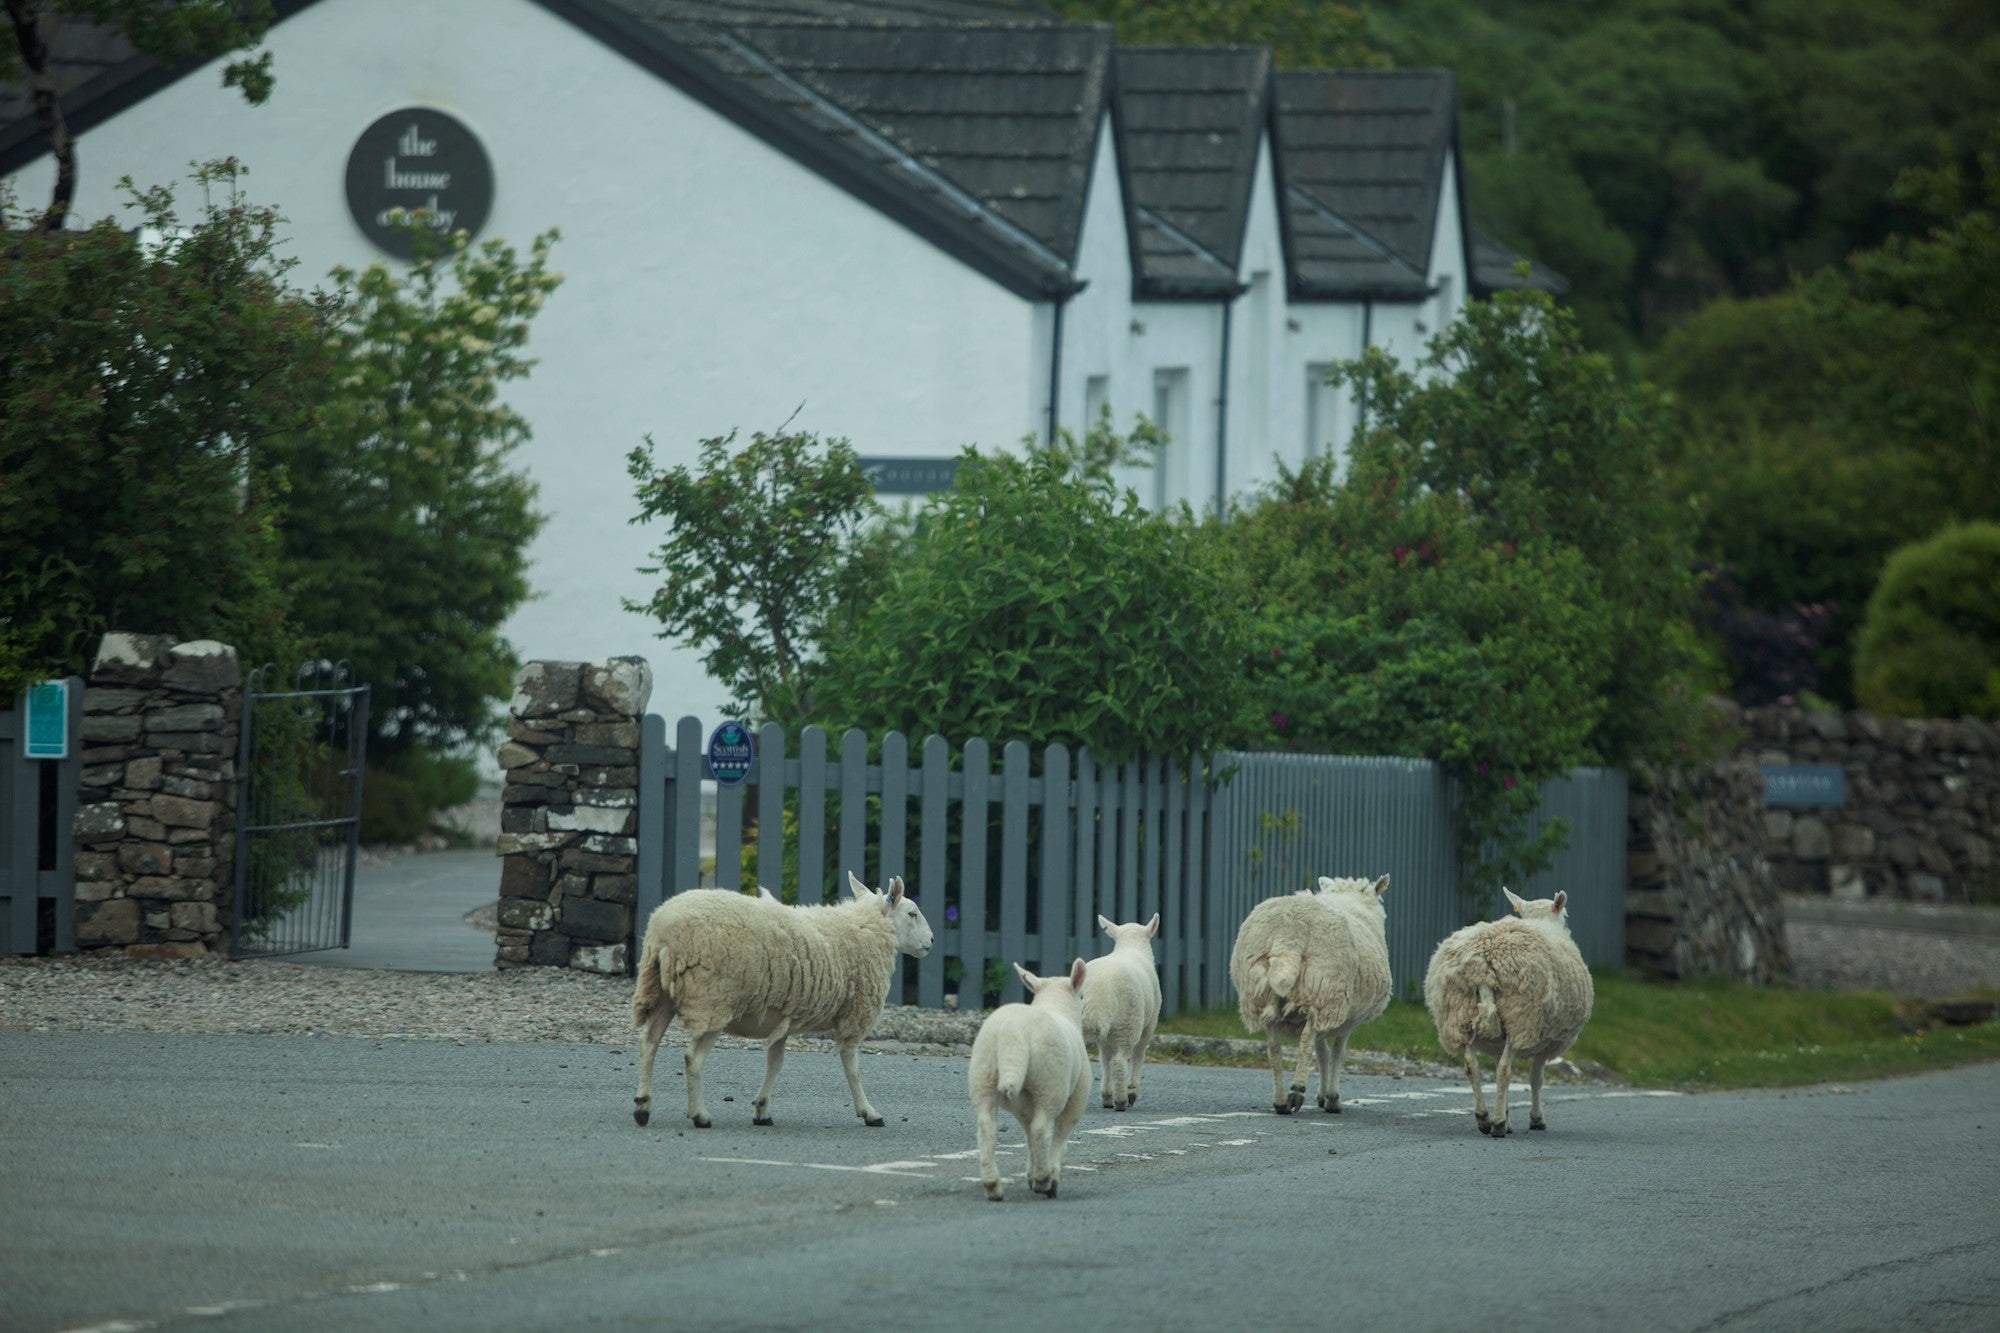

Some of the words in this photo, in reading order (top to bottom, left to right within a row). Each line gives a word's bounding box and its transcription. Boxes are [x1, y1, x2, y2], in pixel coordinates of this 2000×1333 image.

[398, 123, 438, 157] the
[384, 156, 451, 190] house
[713, 743, 748, 755] Scottish
